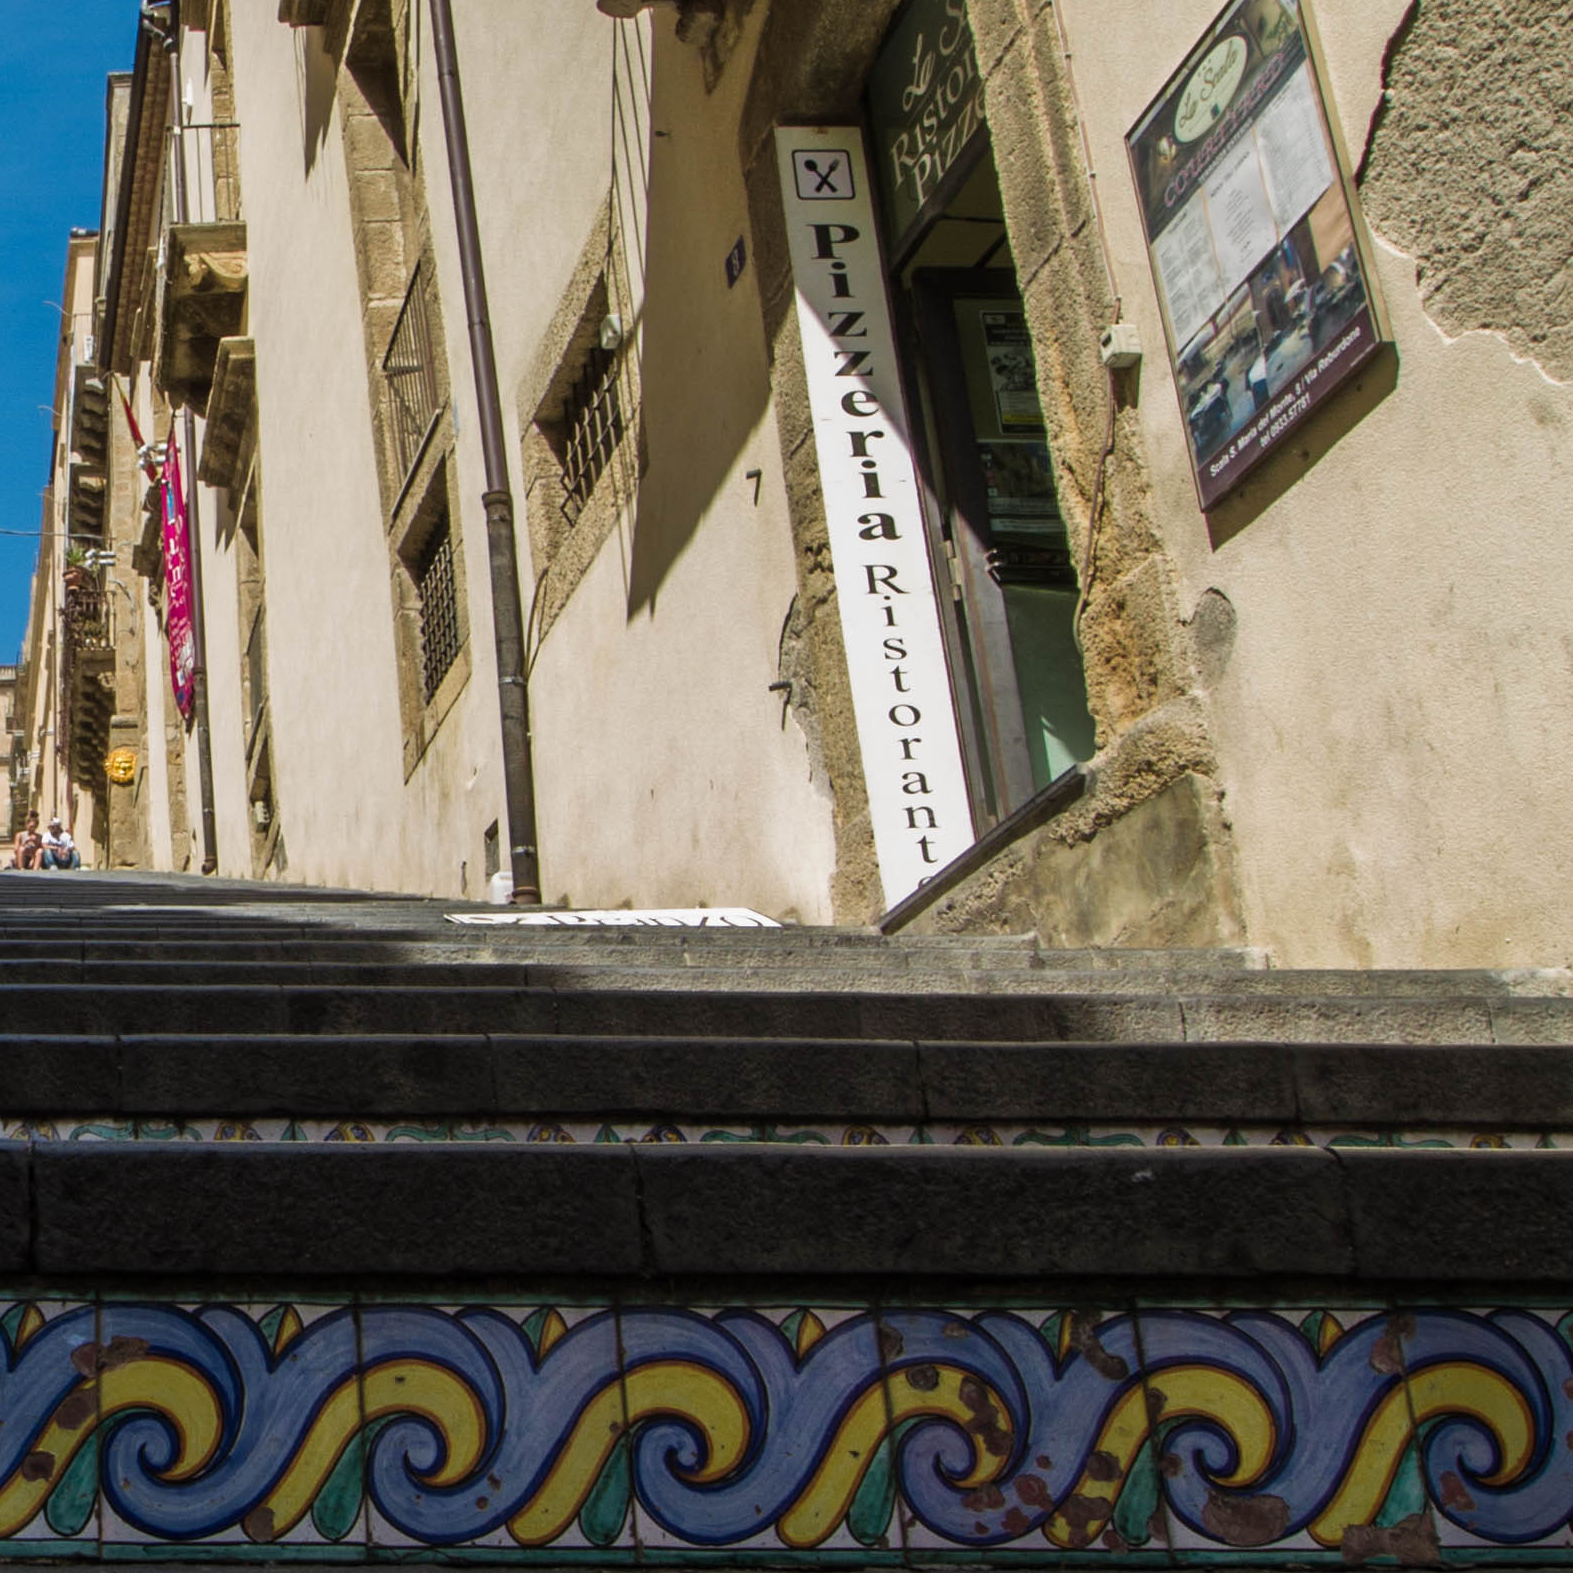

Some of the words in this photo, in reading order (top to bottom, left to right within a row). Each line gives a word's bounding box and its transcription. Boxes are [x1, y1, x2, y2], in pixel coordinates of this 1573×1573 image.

[902, 33, 935, 112] La
[1179, 92, 1197, 129] La
[807, 223, 902, 541] Pizzeria
[1210, 454, 1230, 477] Scala
[1237, 427, 1257, 451] Maria
[1257, 414, 1270, 431] del
[1304, 366, 1318, 385] Via
[1259, 431, 1271, 447] tel
